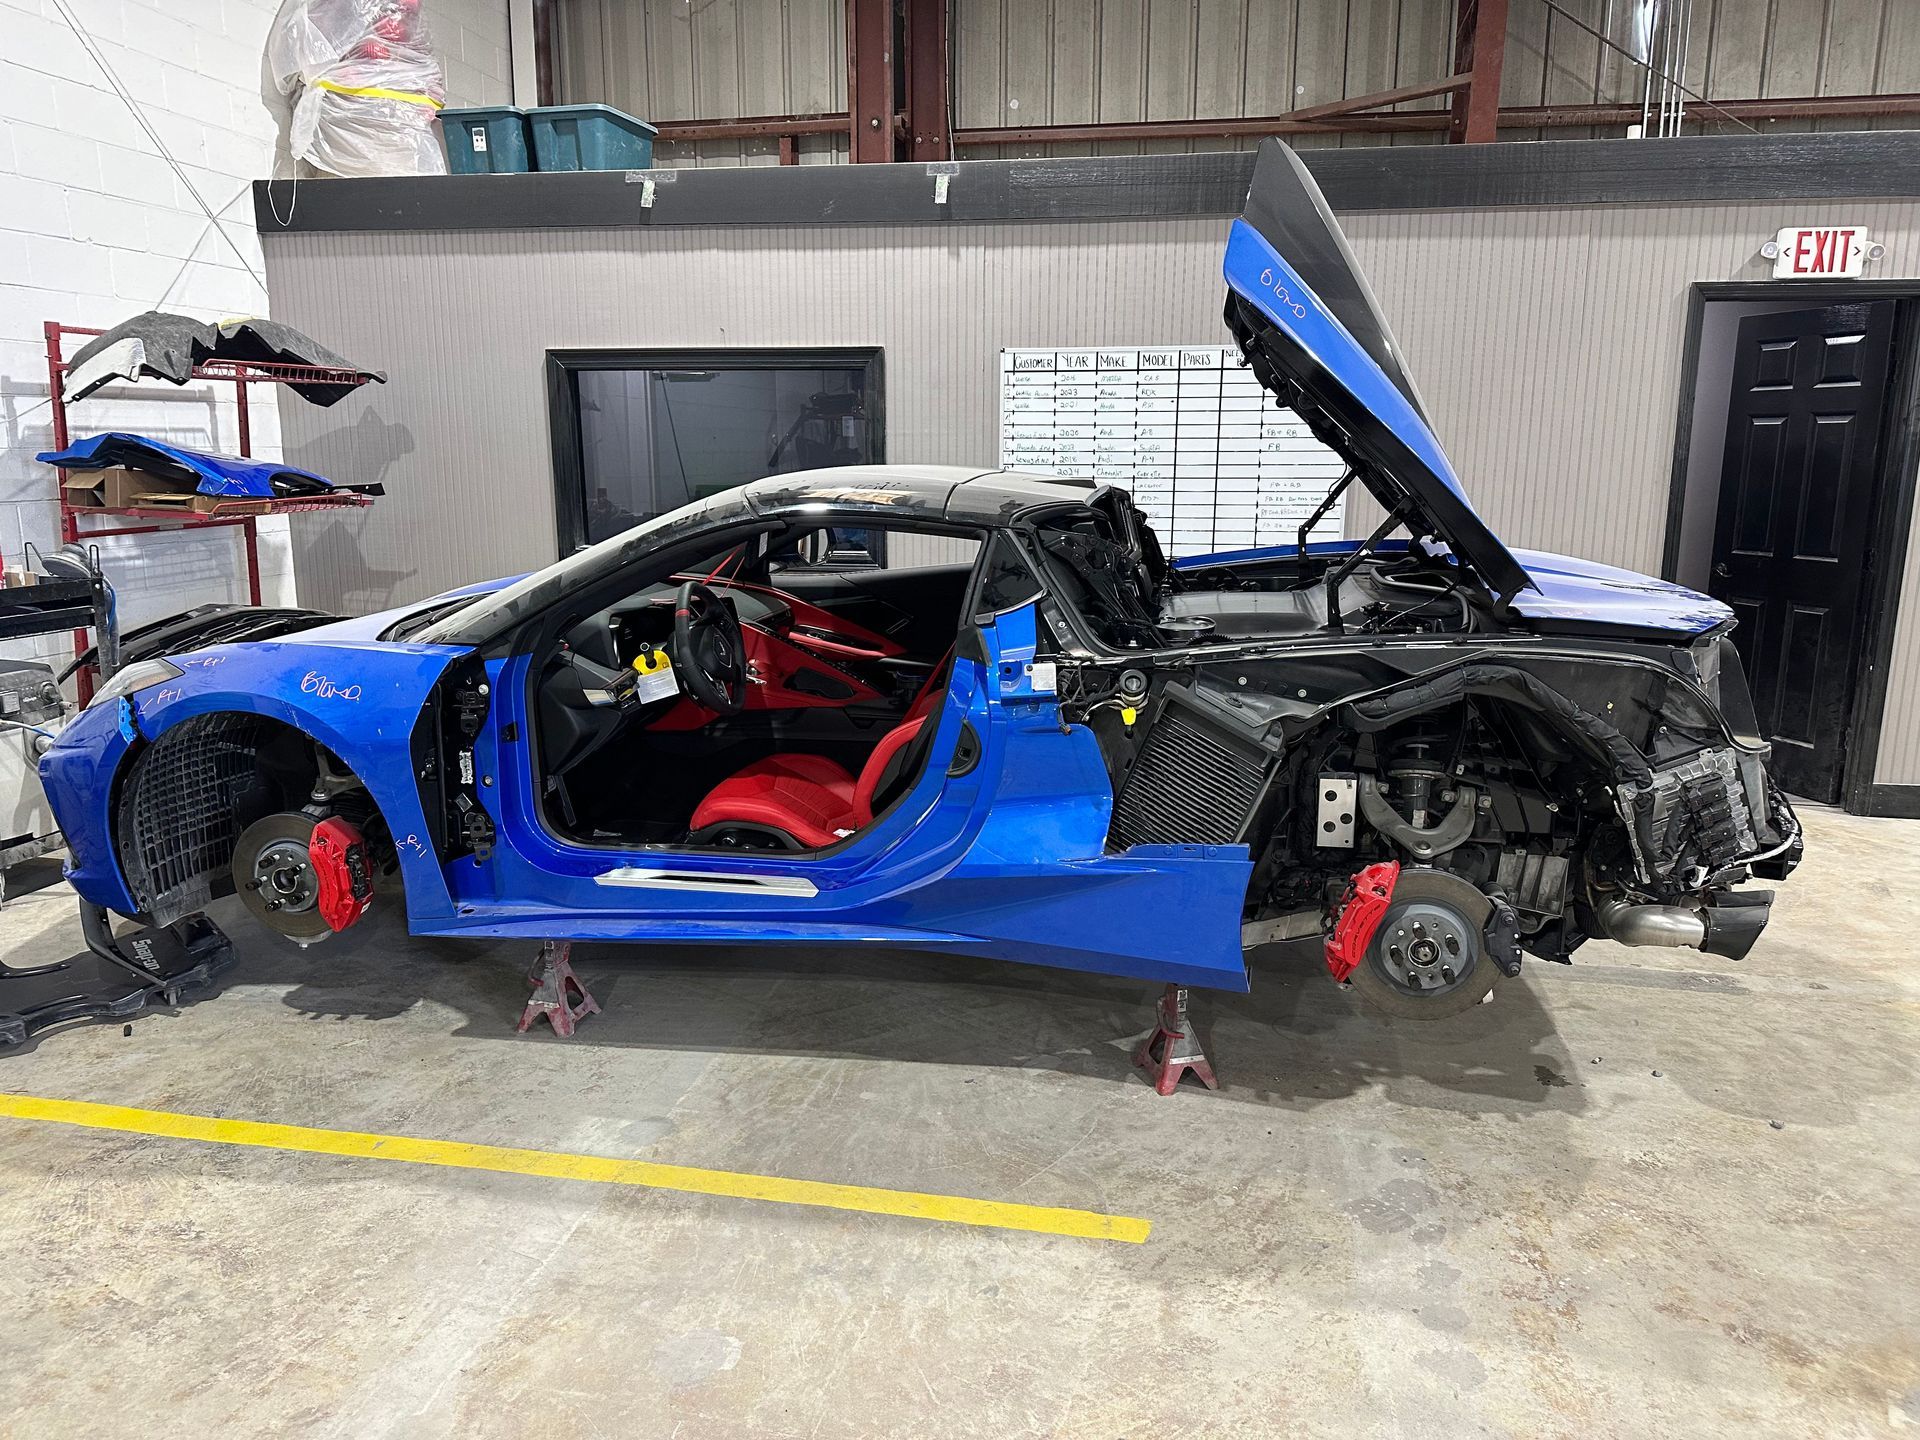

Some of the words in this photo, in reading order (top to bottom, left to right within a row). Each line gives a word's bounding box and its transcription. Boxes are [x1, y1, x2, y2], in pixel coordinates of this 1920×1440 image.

[1793, 230, 1855, 273] EXIT
[1015, 355, 1053, 369] CUSTOMER
[1061, 354, 1089, 368] YEAR
[1100, 354, 1128, 368] MAKE
[1142, 353, 1175, 367] MODEL
[1183, 352, 1211, 367] PARTS
[1268, 443, 1281, 451] FB
[1057, 467, 1079, 476] 2024
[131, 938, 160, 971] Snap-on
